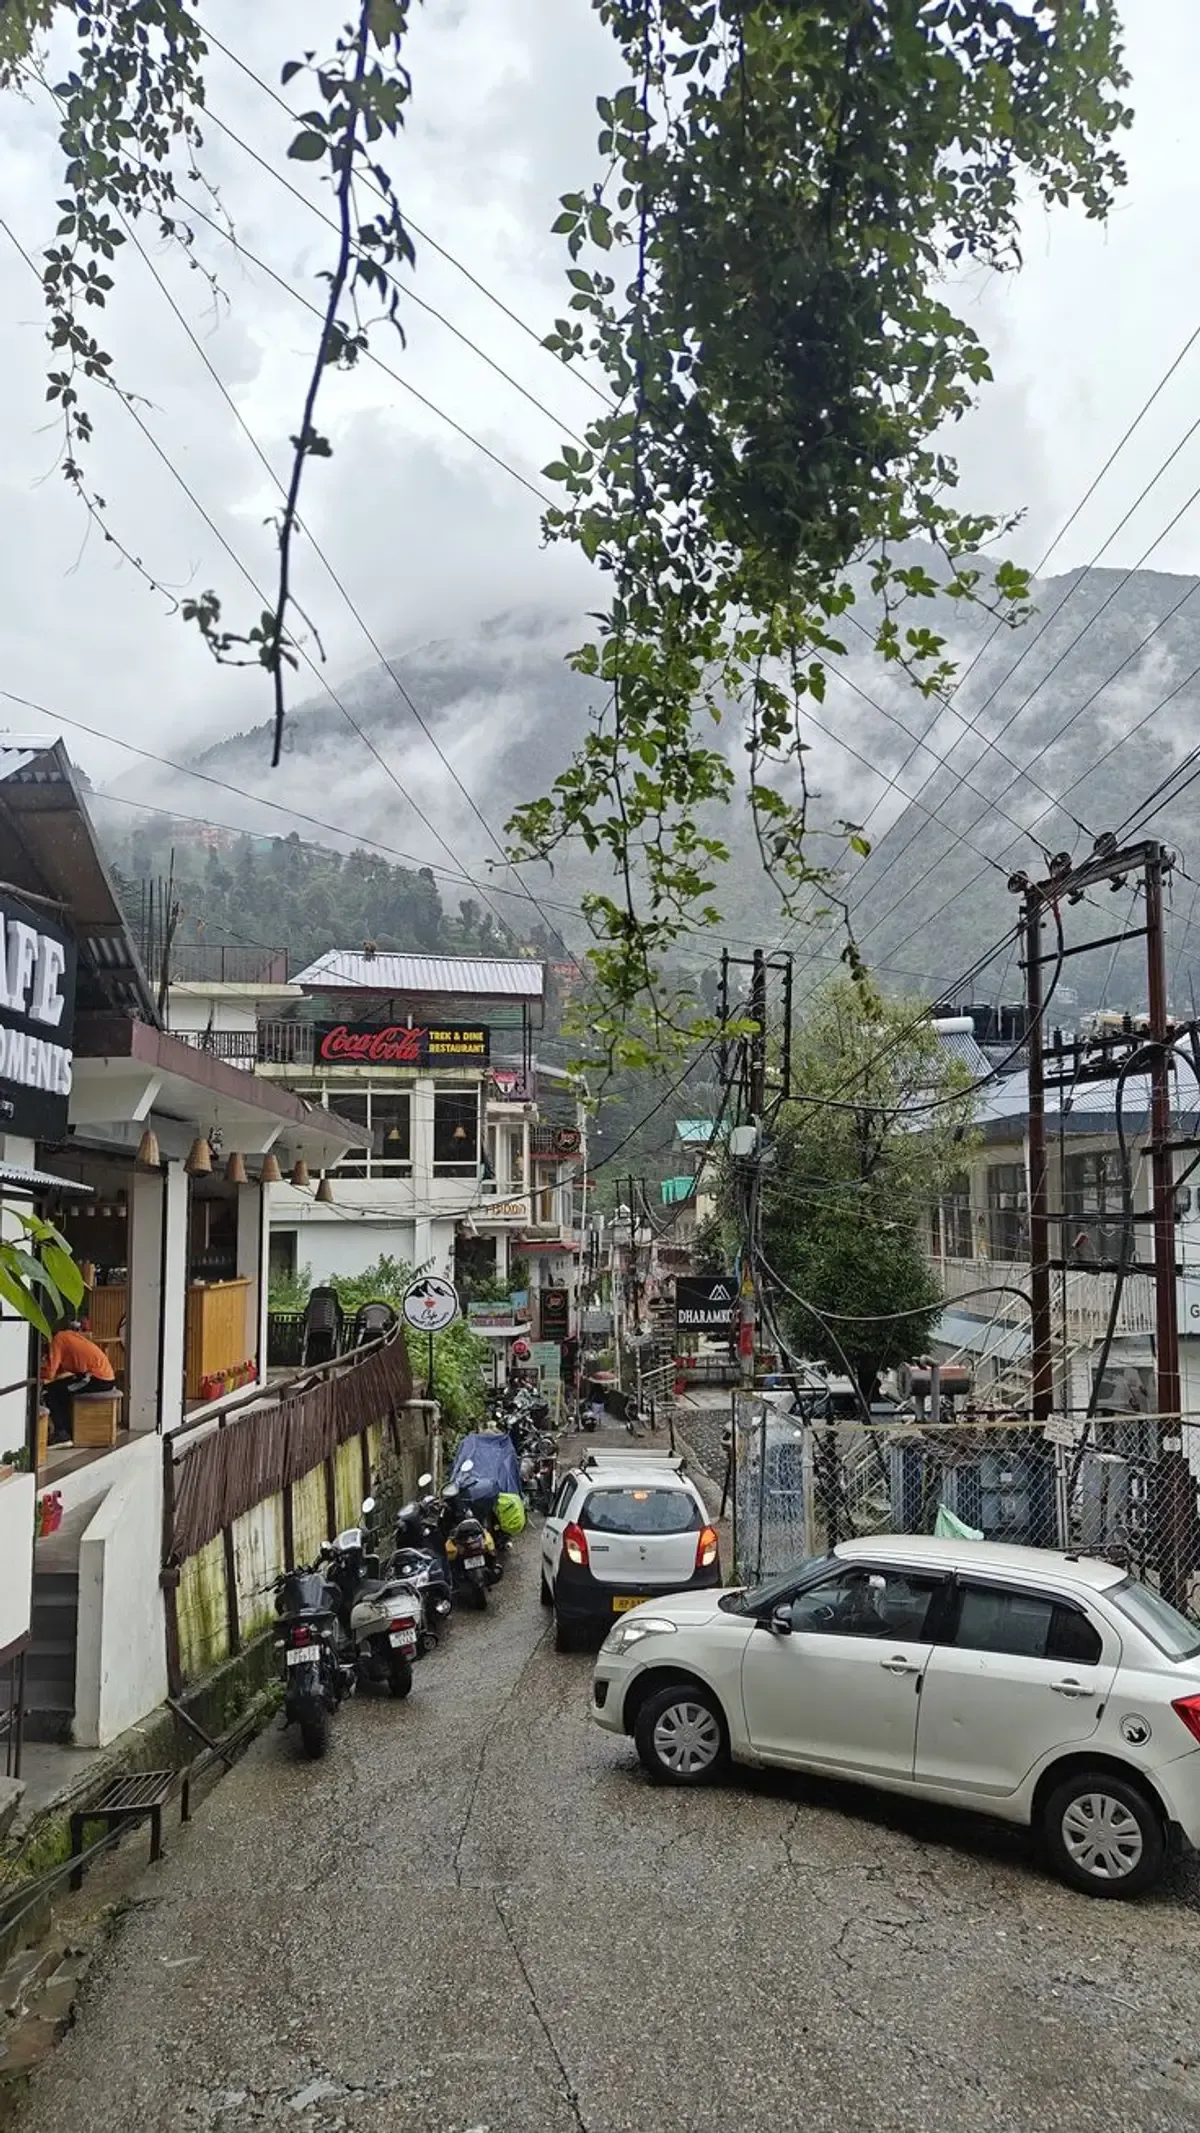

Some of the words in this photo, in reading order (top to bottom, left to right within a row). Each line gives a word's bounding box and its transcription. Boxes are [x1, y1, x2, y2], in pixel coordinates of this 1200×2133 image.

[429, 1031, 451, 1041] TREK
[453, 1031, 460, 1041] &
[462, 1031, 485, 1041] DINE
[428, 1043, 485, 1053] RESTAURANT
